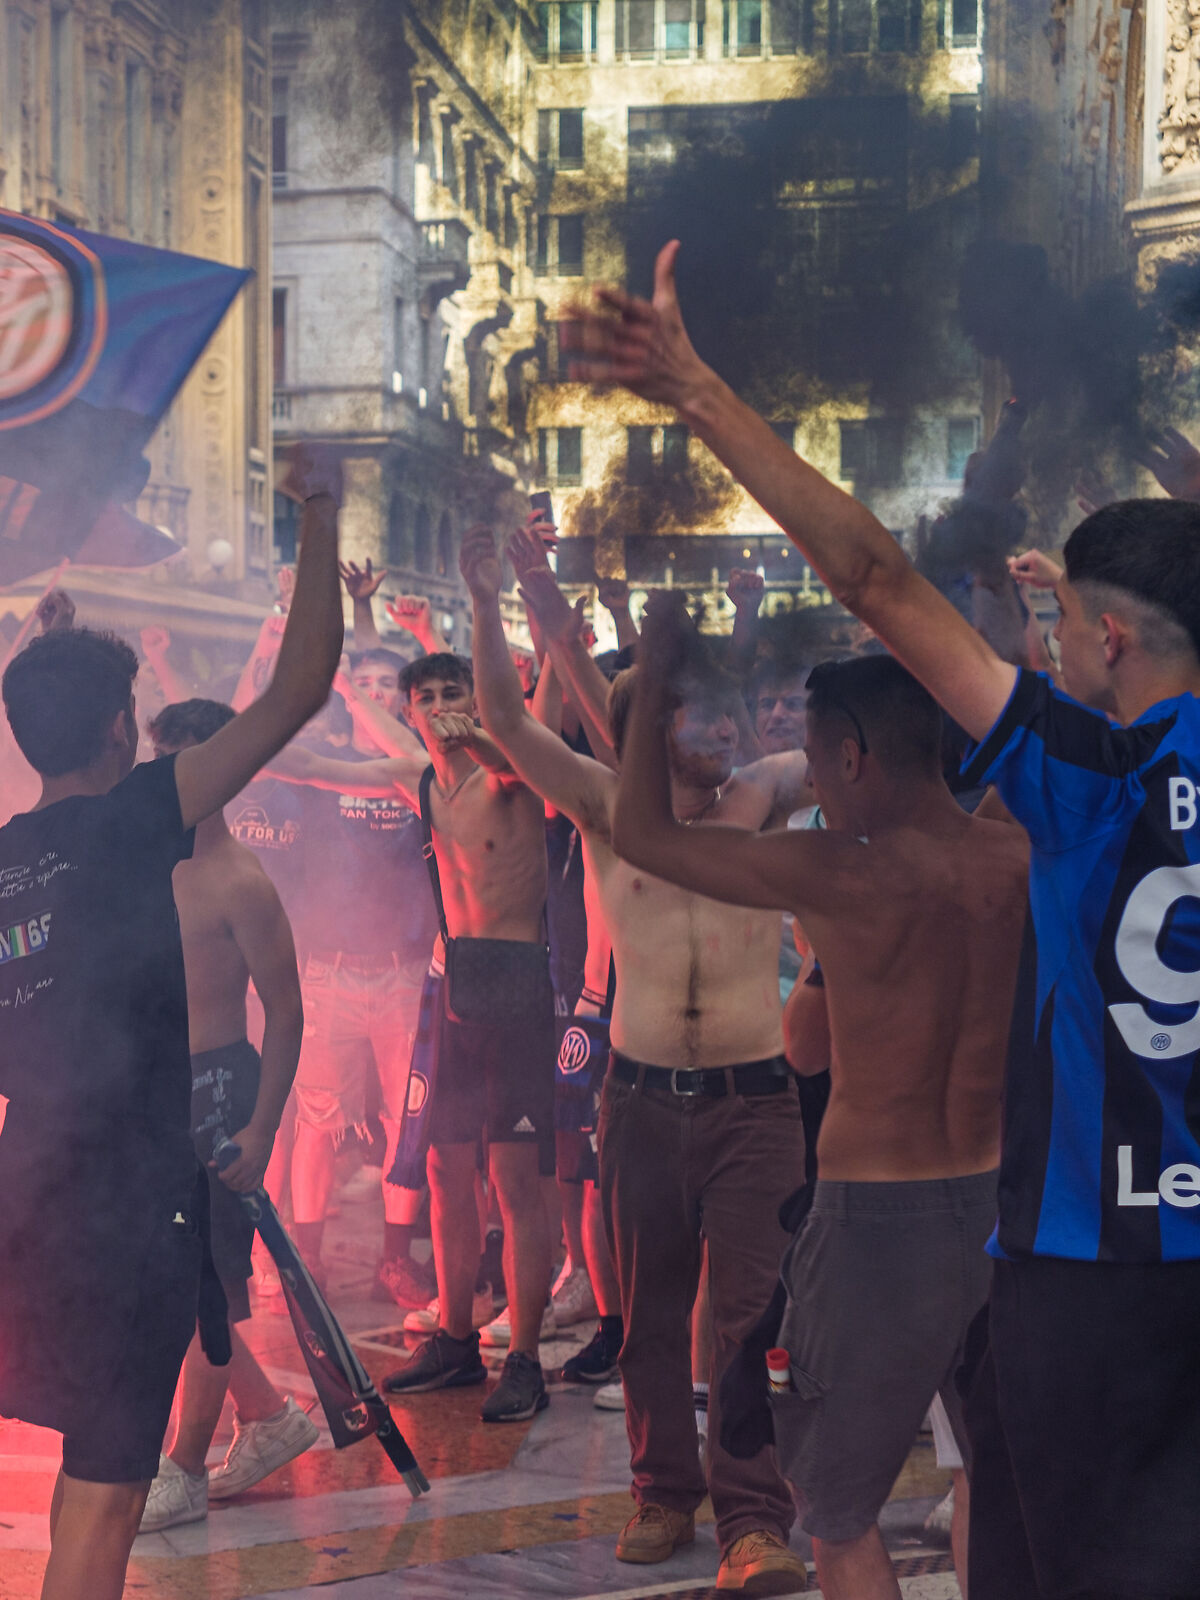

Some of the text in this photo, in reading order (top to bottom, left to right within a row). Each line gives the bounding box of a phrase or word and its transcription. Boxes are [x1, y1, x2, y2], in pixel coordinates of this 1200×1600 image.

[372, 808, 413, 819] TOKN
[1169, 777, 1200, 831] B
[248, 826, 275, 841] FOR
[1108, 864, 1200, 1060] 9
